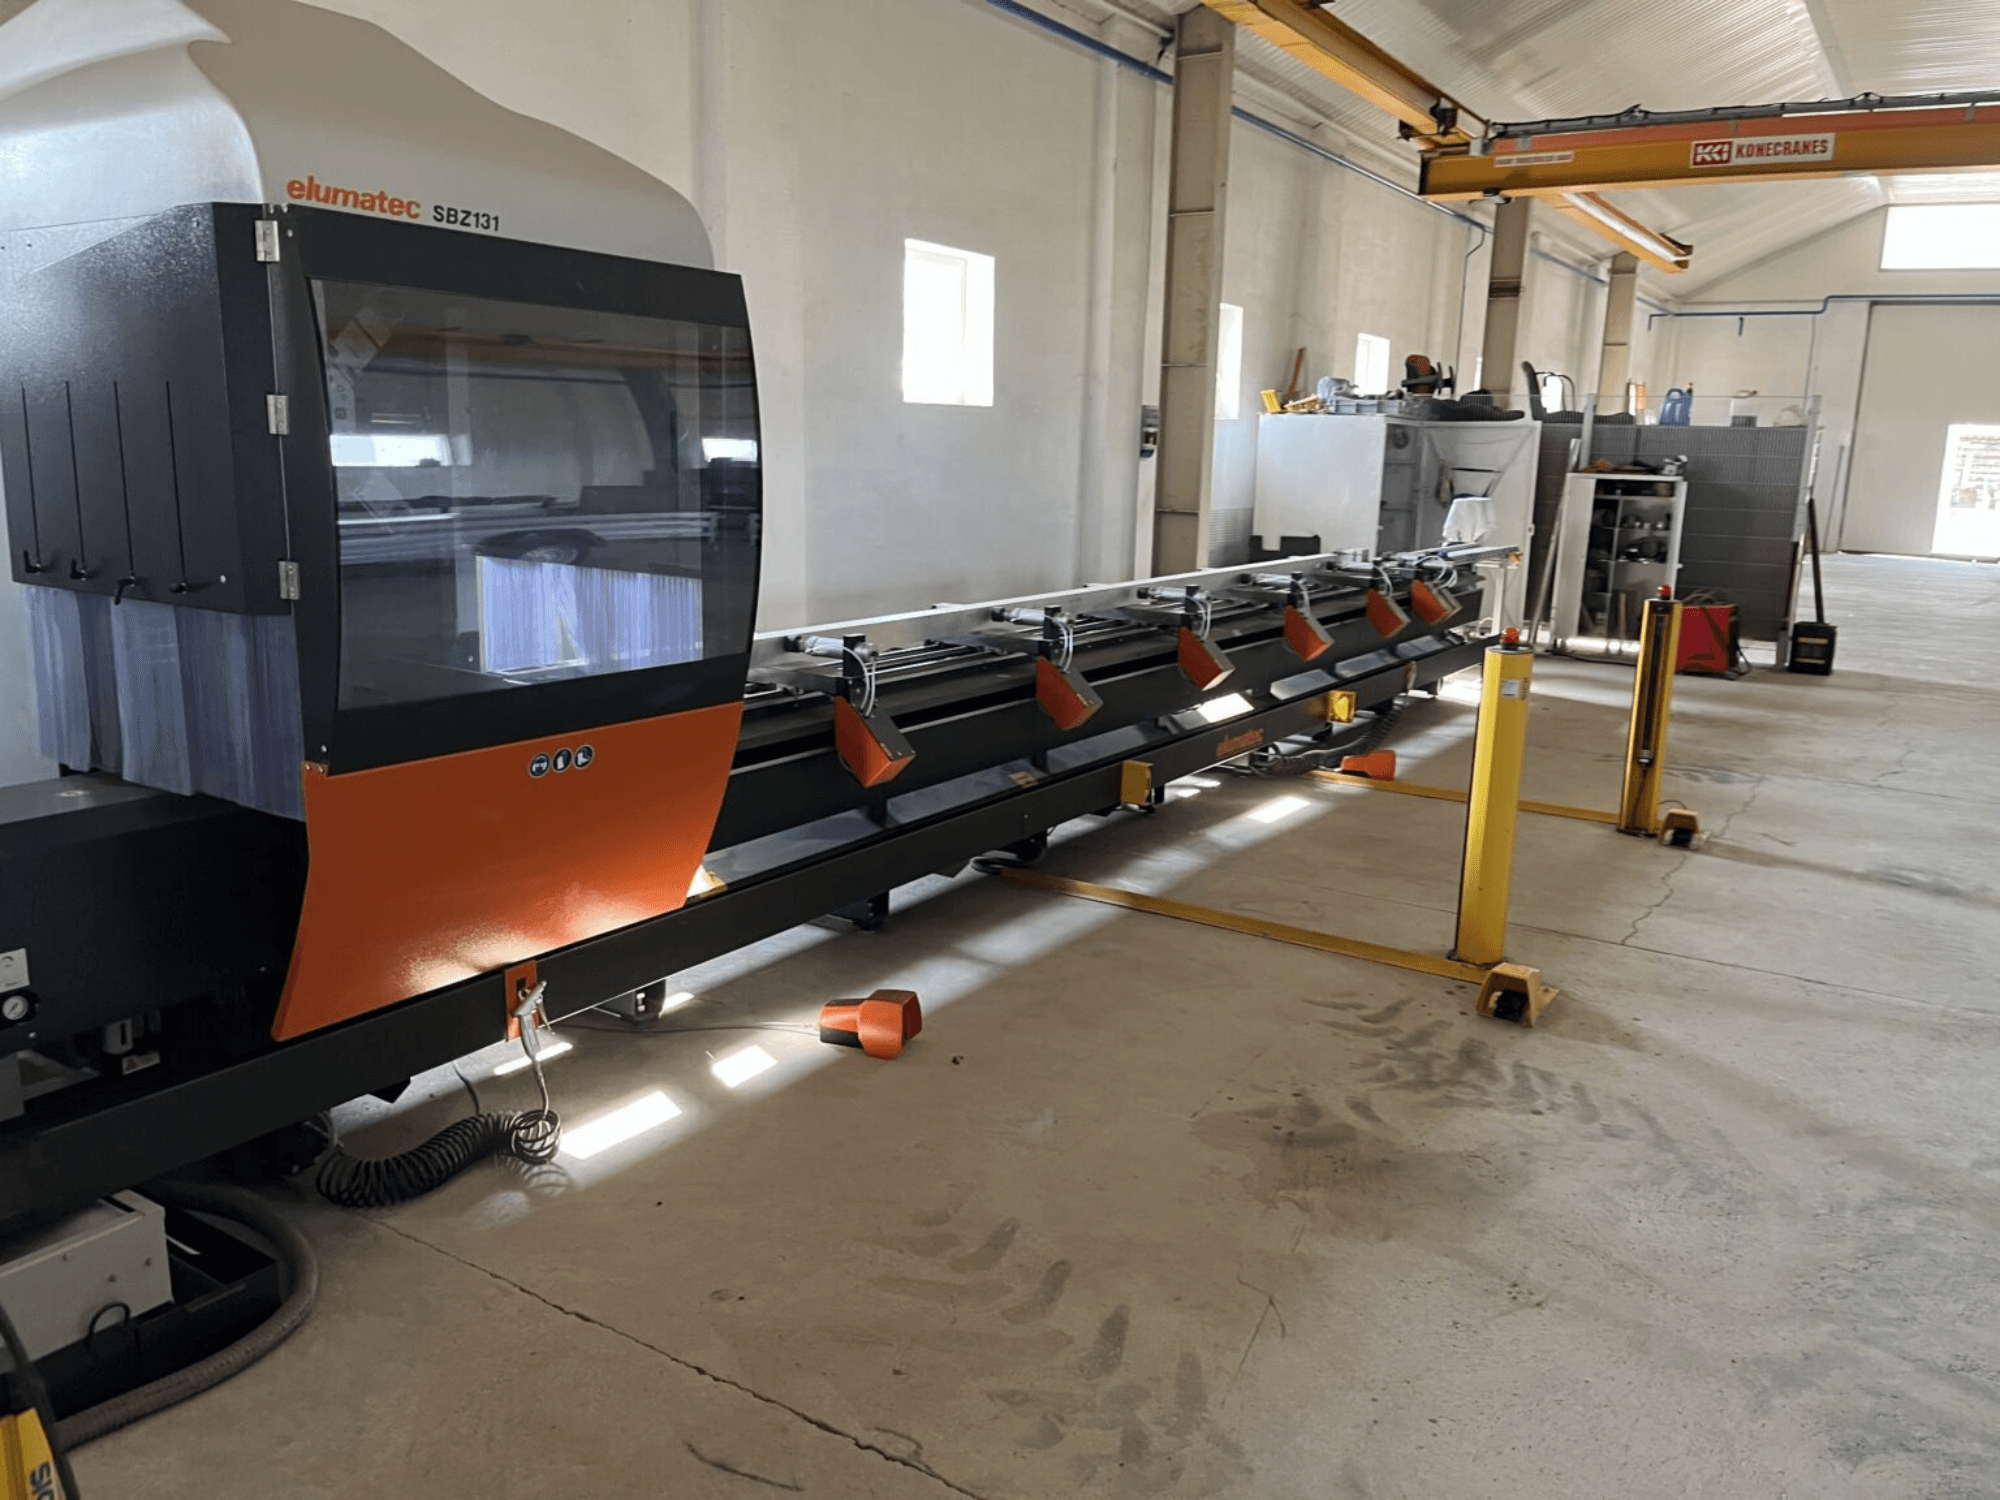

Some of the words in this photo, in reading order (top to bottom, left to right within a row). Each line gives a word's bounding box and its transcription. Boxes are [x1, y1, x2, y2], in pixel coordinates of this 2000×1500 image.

[1735, 139, 1829, 159] KONECRANES
[286, 175, 421, 219] elumatec
[432, 205, 500, 232] SBZ131
